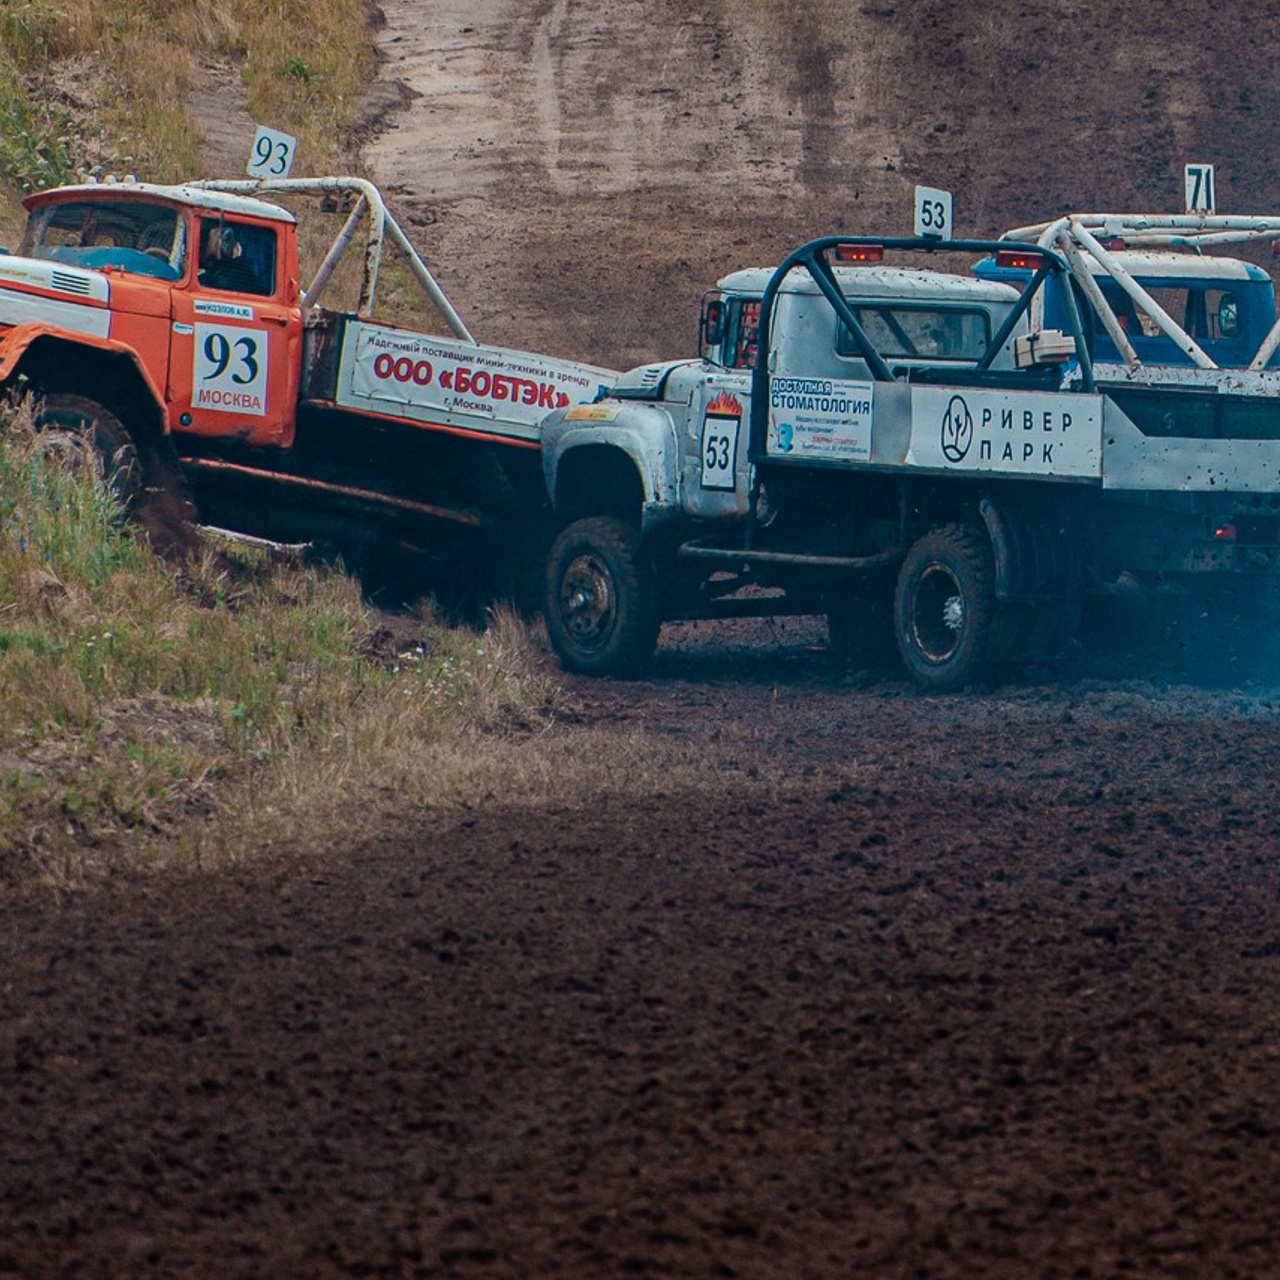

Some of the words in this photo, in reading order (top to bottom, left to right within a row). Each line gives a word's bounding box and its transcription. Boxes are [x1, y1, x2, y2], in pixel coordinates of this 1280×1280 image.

[253, 136, 288, 175] 93
[1188, 168, 1212, 210] 71
[921, 200, 945, 230] 53
[203, 333, 259, 384] 93
[368, 336, 420, 353] Надежный
[421, 347, 474, 364] поставщик
[557, 372, 590, 388] аренду
[374, 353, 433, 386] ООО
[438, 367, 571, 410] «БОБТЭК»
[771, 378, 832, 395] ДОСТУПНАЯ
[199, 389, 261, 409] МОСКВА
[452, 397, 493, 413] Москва
[772, 395, 870, 415] СТОМАТОЛОГИЯ
[982, 408, 1073, 432] РИВЕР
[706, 436, 730, 470] 53
[980, 440, 1054, 463] ПАРК
